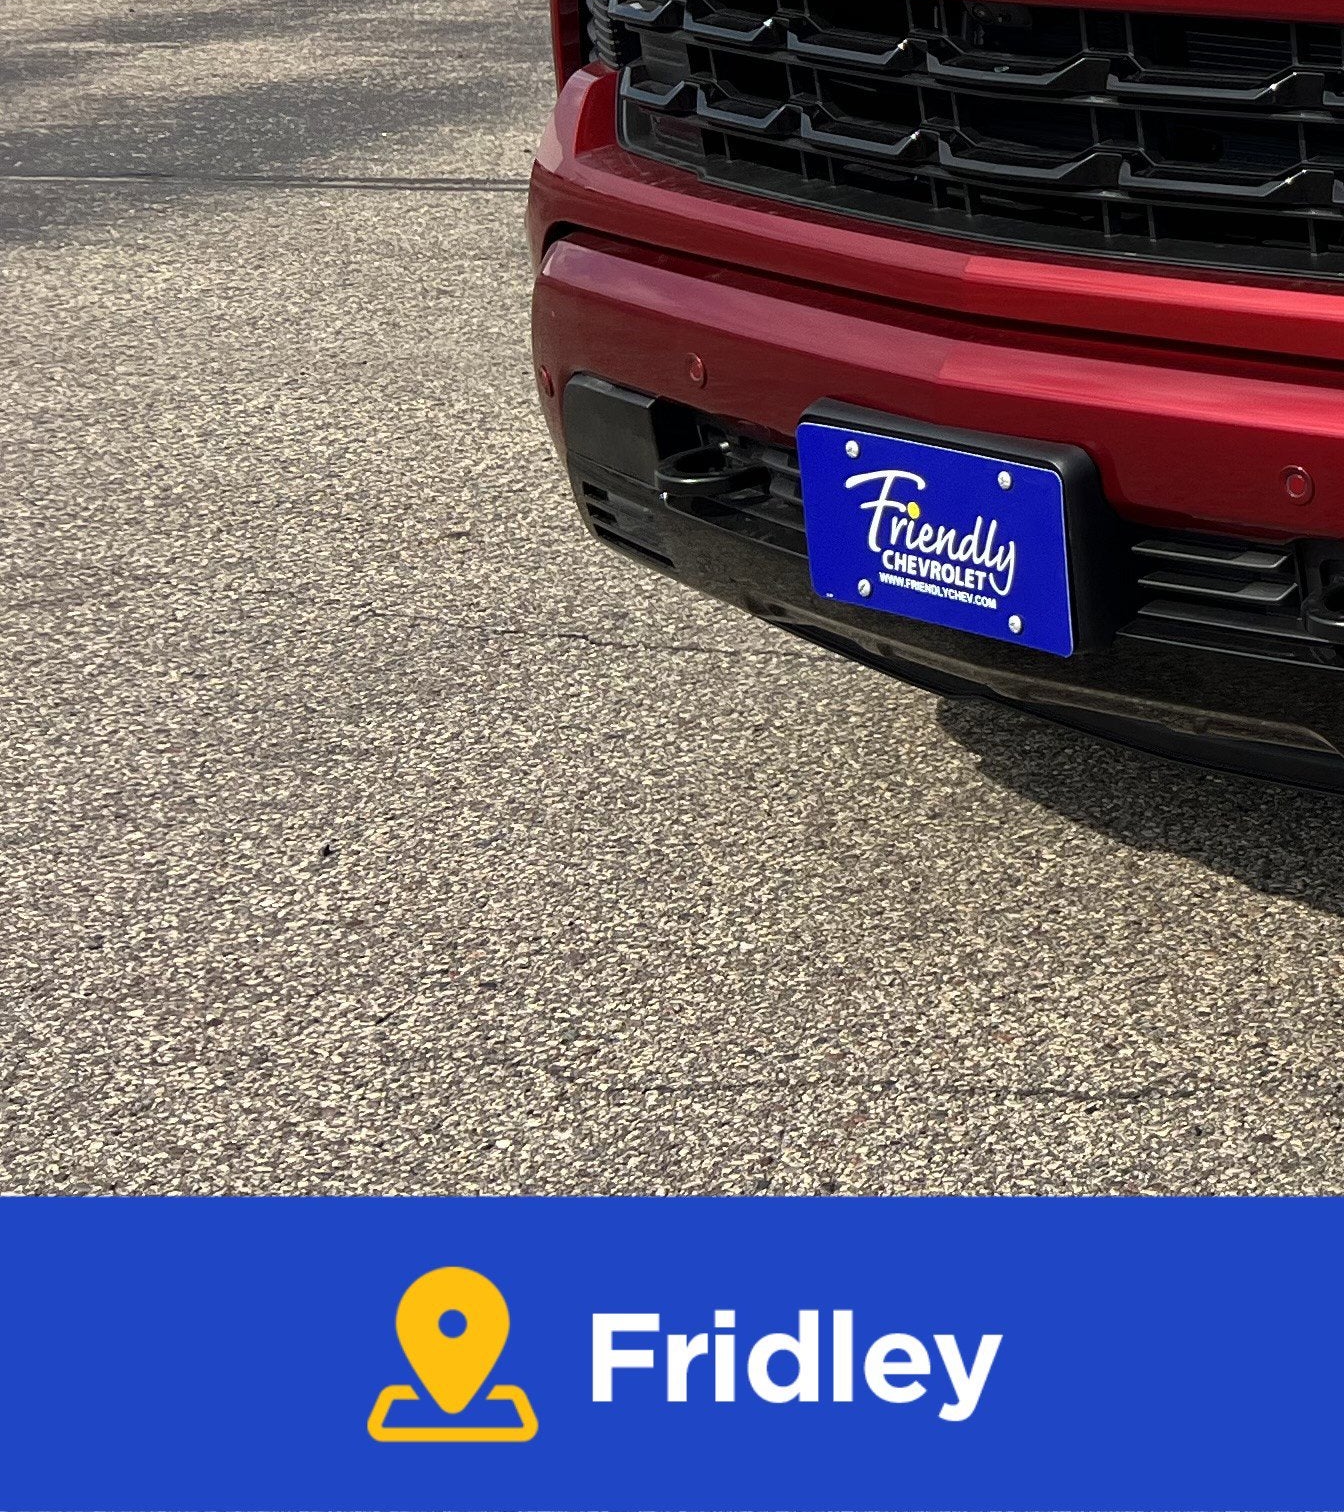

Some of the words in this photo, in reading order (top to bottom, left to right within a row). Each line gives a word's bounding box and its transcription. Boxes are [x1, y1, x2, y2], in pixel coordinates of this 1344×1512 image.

[845, 470, 1016, 596] Friendly
[878, 571, 997, 609] WWW.FRIENDLYCHEV.COM
[882, 549, 987, 591] CHEVROLET
